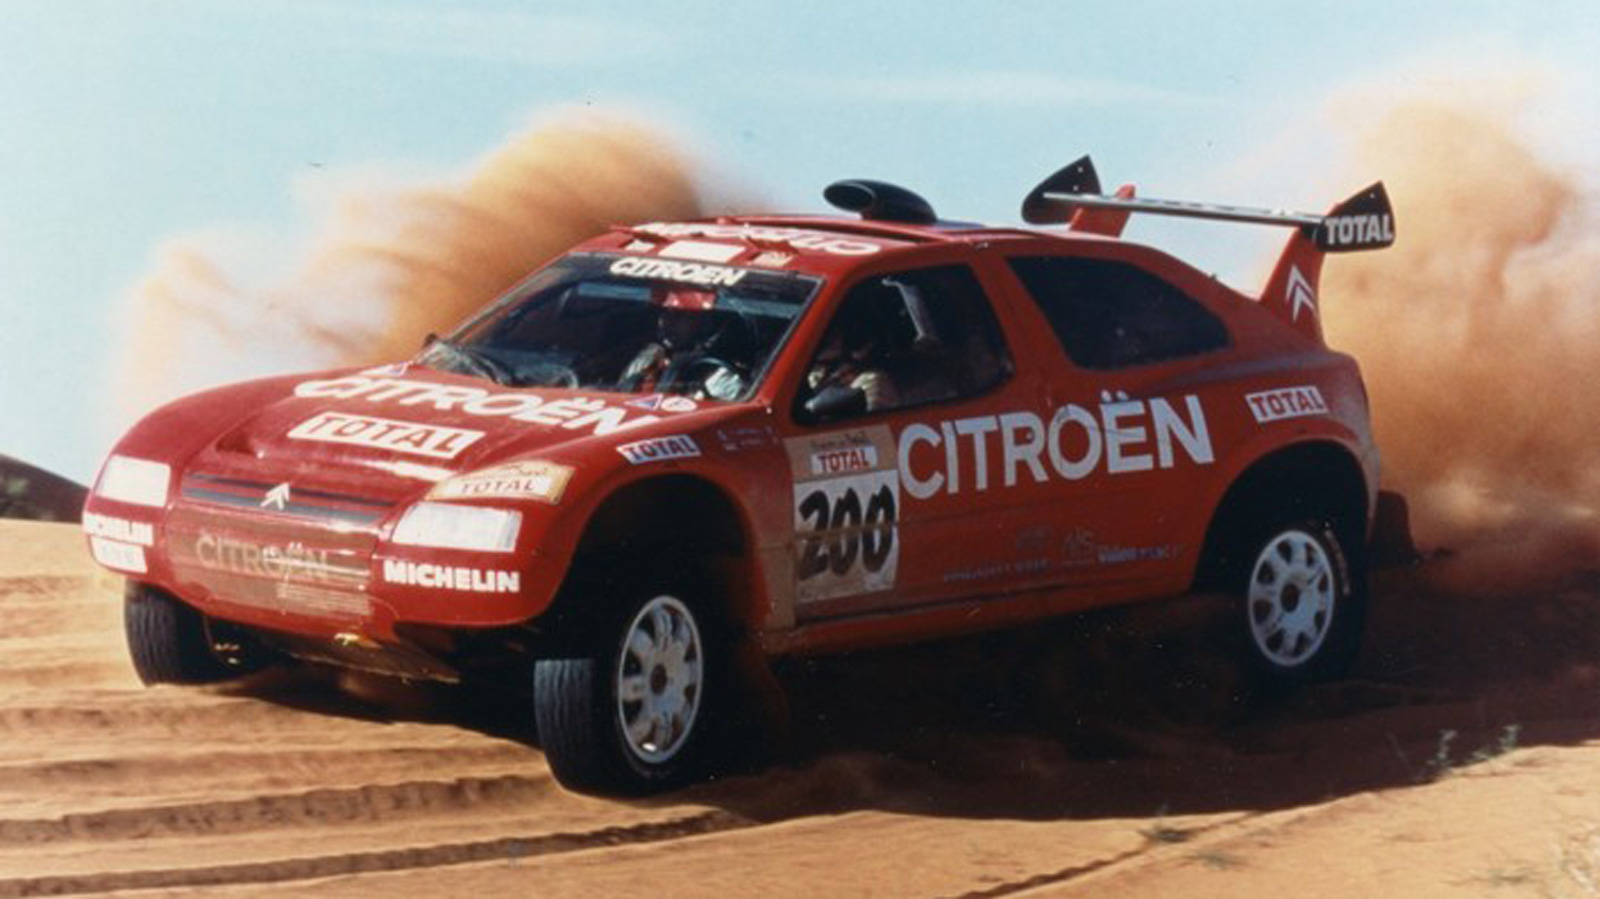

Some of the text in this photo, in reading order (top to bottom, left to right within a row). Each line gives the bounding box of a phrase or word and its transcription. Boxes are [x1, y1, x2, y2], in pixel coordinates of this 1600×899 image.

[1325, 214, 1393, 245] TOTAL
[294, 376, 660, 436] CITROËN
[1250, 389, 1324, 418] TOTAL
[307, 416, 462, 453] TOTAL
[626, 435, 694, 462] TOTAL
[897, 389, 1215, 500] CITROËN
[817, 448, 870, 472] TOTAL
[461, 479, 535, 495] TOTAL
[799, 484, 896, 581] 200
[384, 560, 520, 592] MICHELIN
